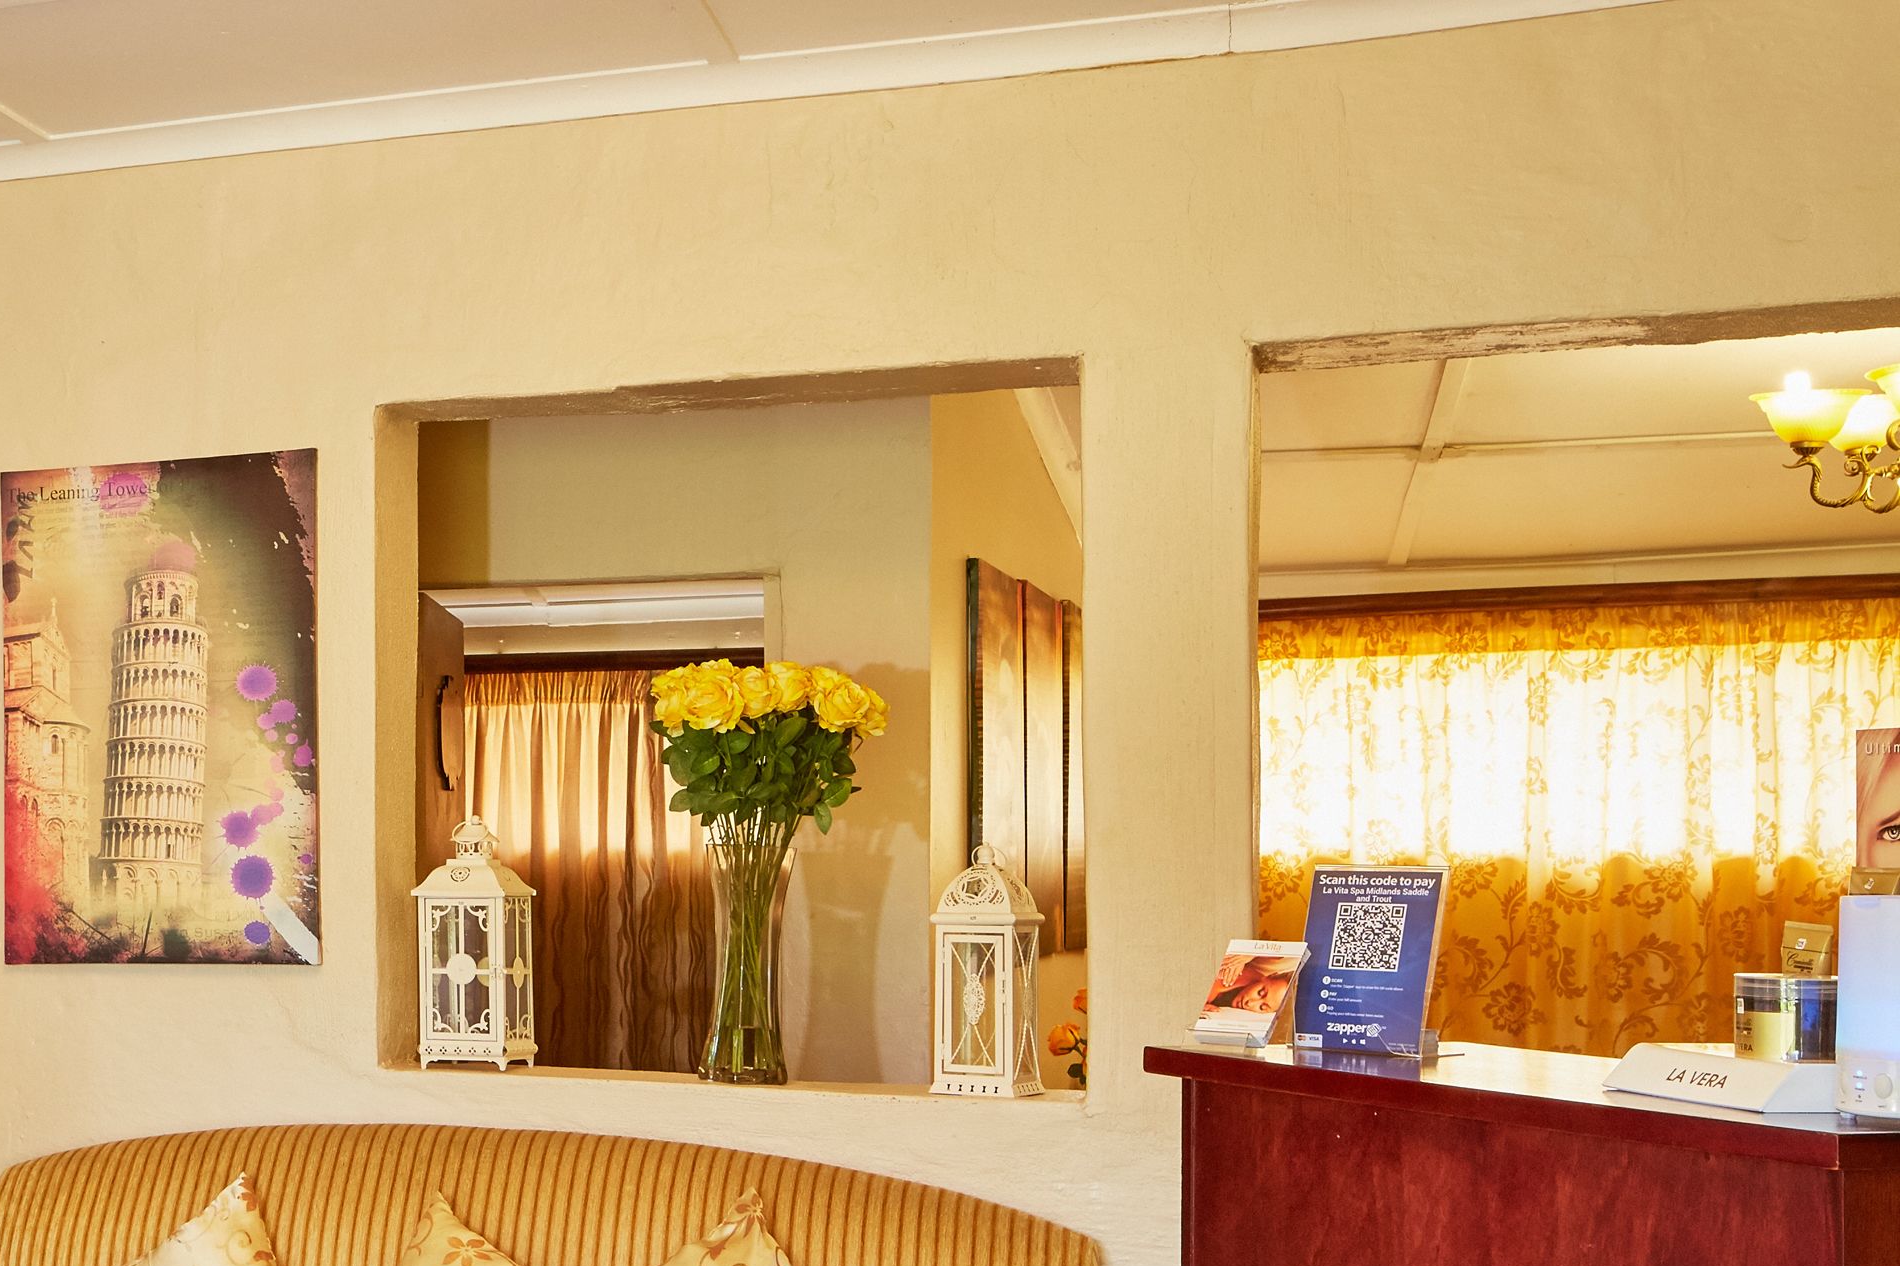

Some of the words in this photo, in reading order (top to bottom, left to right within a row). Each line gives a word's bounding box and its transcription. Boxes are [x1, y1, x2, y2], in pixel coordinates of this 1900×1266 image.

[40, 486, 100, 502] Leaning
[1319, 874, 1346, 885] Scan
[1347, 875, 1369, 886] this
[1370, 875, 1398, 887] code
[1399, 876, 1412, 887] to
[1413, 878, 1436, 889] pay
[1322, 886, 1333, 894] La
[1333, 887, 1349, 895] Vita
[1350, 887, 1365, 896] Spa
[1366, 887, 1401, 896] Midlands
[1402, 888, 1430, 896] Saddle
[1371, 895, 1392, 903] Trout
[1326, 1021, 1367, 1036] zapper
[1665, 1068, 1686, 1083] LA
[1690, 1071, 1729, 1089] VERA
